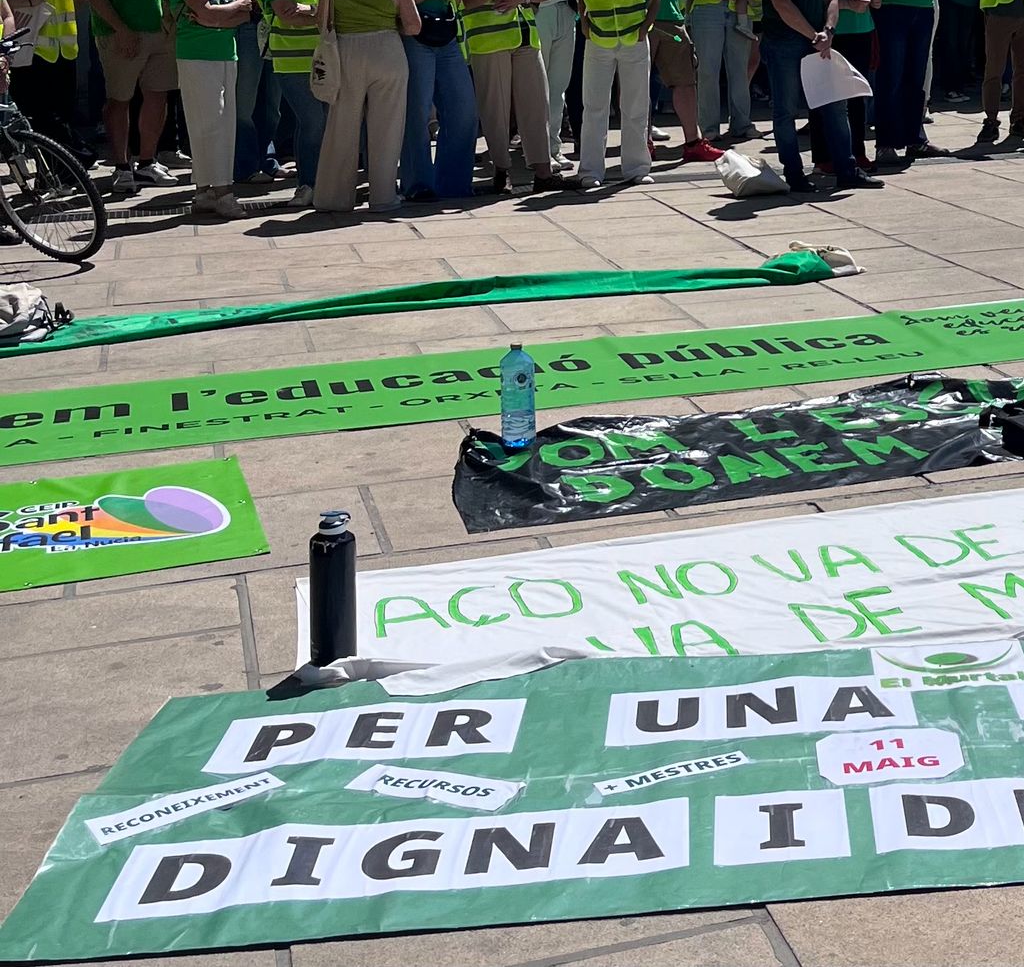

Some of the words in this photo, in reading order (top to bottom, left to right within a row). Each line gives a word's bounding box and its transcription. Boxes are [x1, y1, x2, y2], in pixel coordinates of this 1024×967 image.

[93, 405, 348, 438] FINESTRAT
[399, 382, 579, 407] ORXA
[618, 367, 740, 384] SELLA
[781, 350, 925, 371] RELLEU
[171, 353, 592, 412] l'educacó
[617, 330, 892, 370] pública
[560, 435, 930, 503] DONEM
[20, 501, 79, 514] CEIP
[0, 524, 91, 552] fael
[373, 574, 584, 639] AÇÒ
[616, 559, 739, 605] NO
[751, 544, 882, 584] VA
[895, 523, 1024, 569] DE
[787, 585, 922, 643] DE
[879, 677, 912, 689] El
[242, 708, 493, 763] PER
[635, 685, 896, 733] UNA
[869, 738, 905, 751] 11
[378, 774, 496, 798] RECURSOS
[624, 752, 742, 788] MESTRES
[842, 755, 940, 775] MAIG
[100, 776, 272, 835] RECONEIXEMENT
[137, 816, 666, 905] DIGNA
[758, 802, 806, 850] I
